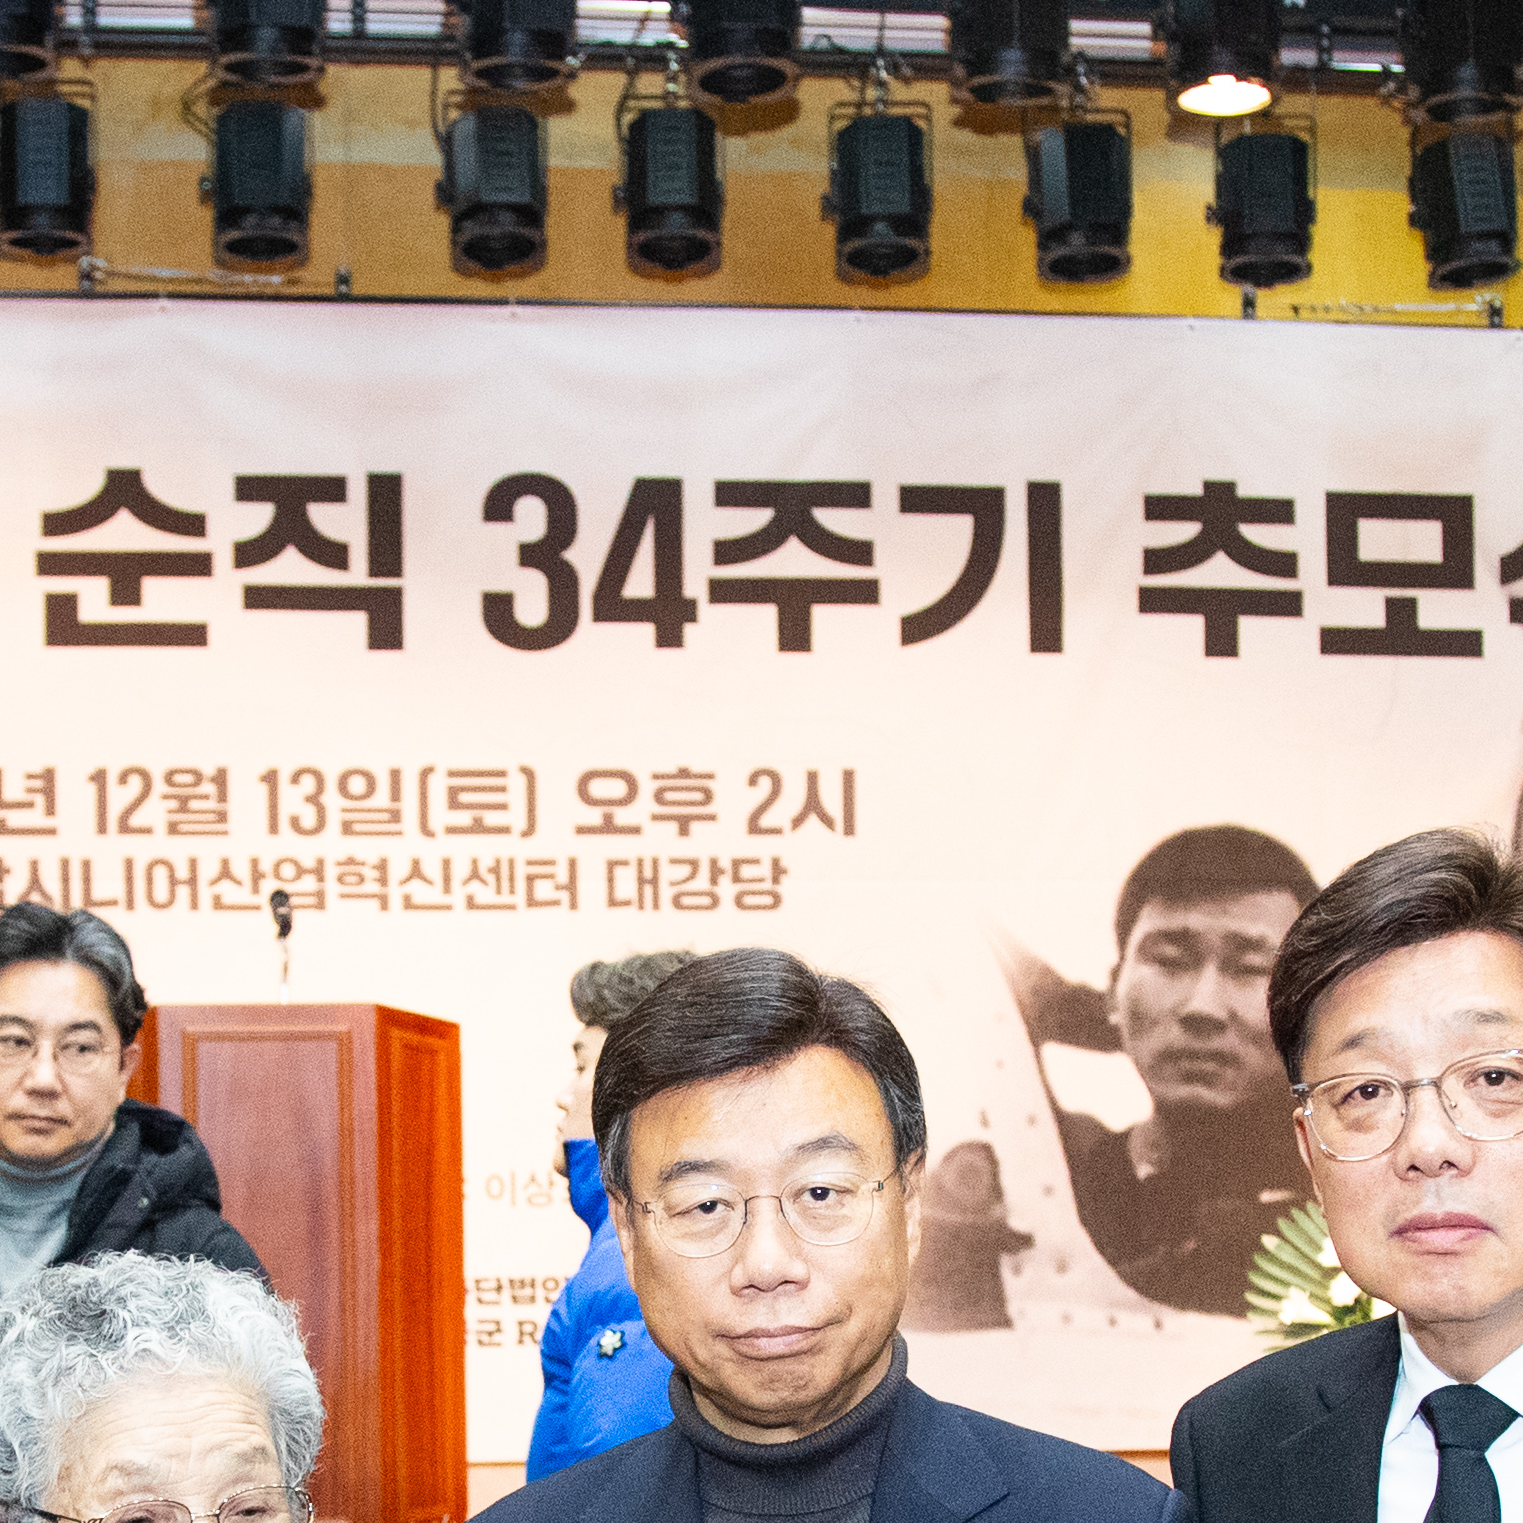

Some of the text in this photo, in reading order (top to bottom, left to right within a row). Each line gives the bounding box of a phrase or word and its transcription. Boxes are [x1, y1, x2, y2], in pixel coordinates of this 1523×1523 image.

[35, 467, 405, 651] 순직
[481, 471, 1064, 654] 34주기
[86, 766, 230, 837] 12월
[573, 767, 719, 838] 오후
[746, 767, 857, 837] 2시
[605, 855, 789, 913] 대강당
[485, 1170, 570, 1208] 이상
